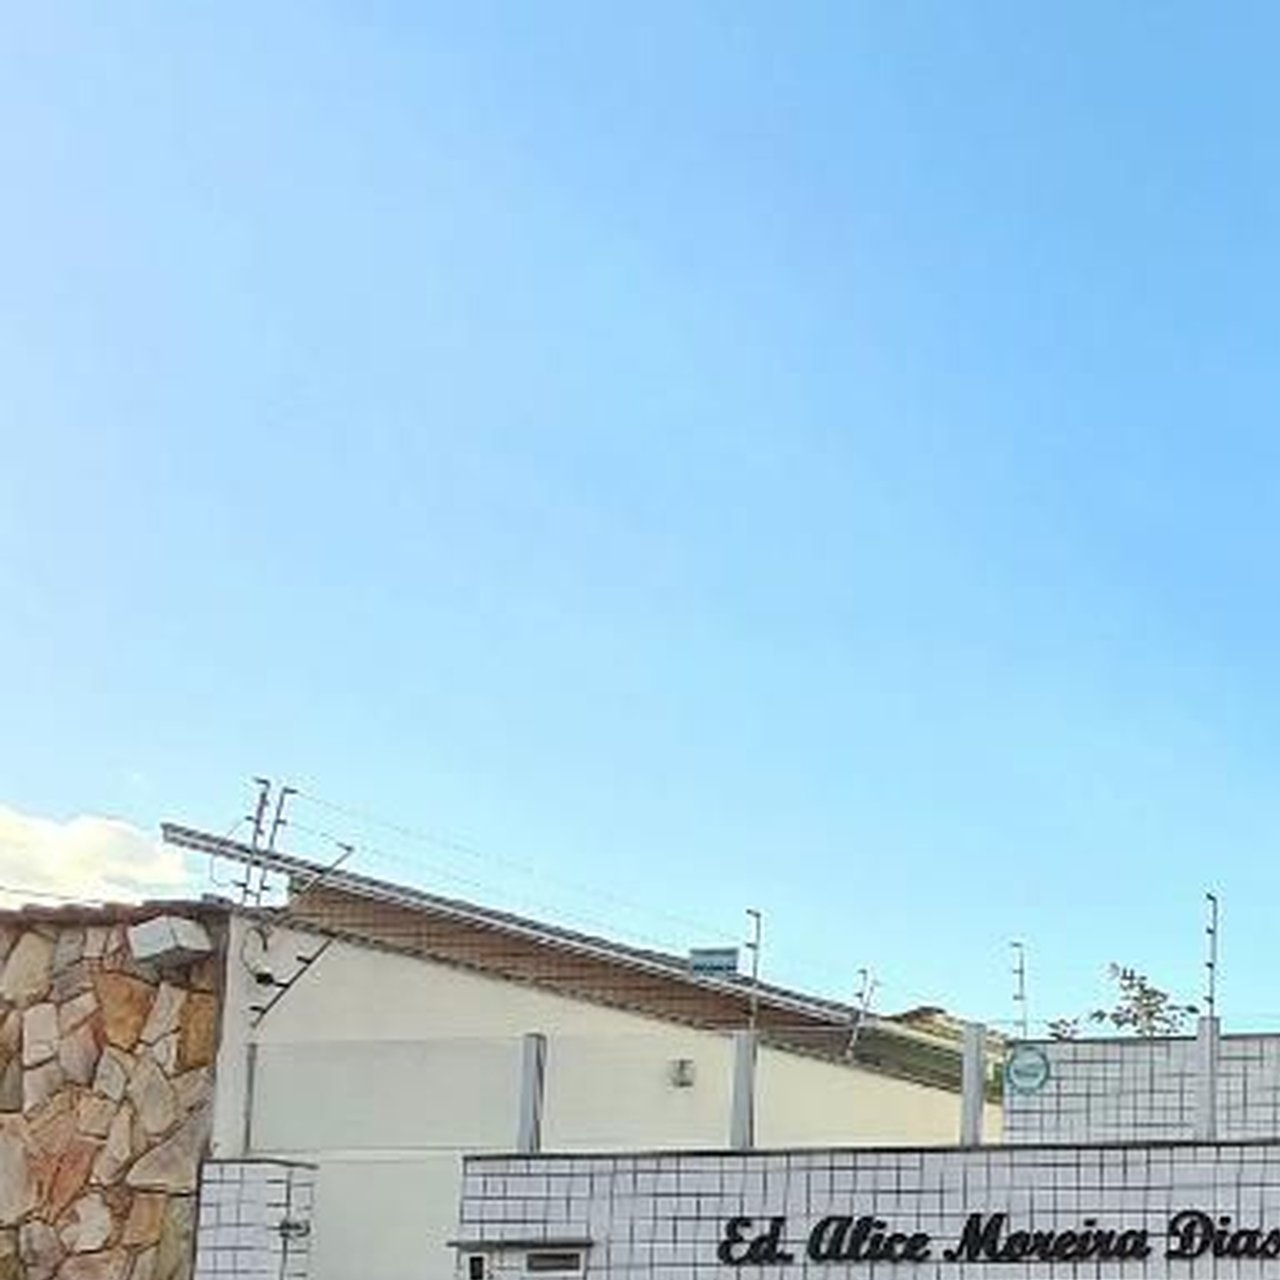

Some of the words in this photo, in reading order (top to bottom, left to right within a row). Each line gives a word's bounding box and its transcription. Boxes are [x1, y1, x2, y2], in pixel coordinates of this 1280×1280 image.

[717, 1216, 794, 1266] Ed.
[807, 1215, 931, 1262] Alice
[943, 1212, 1151, 1262] Moreira
